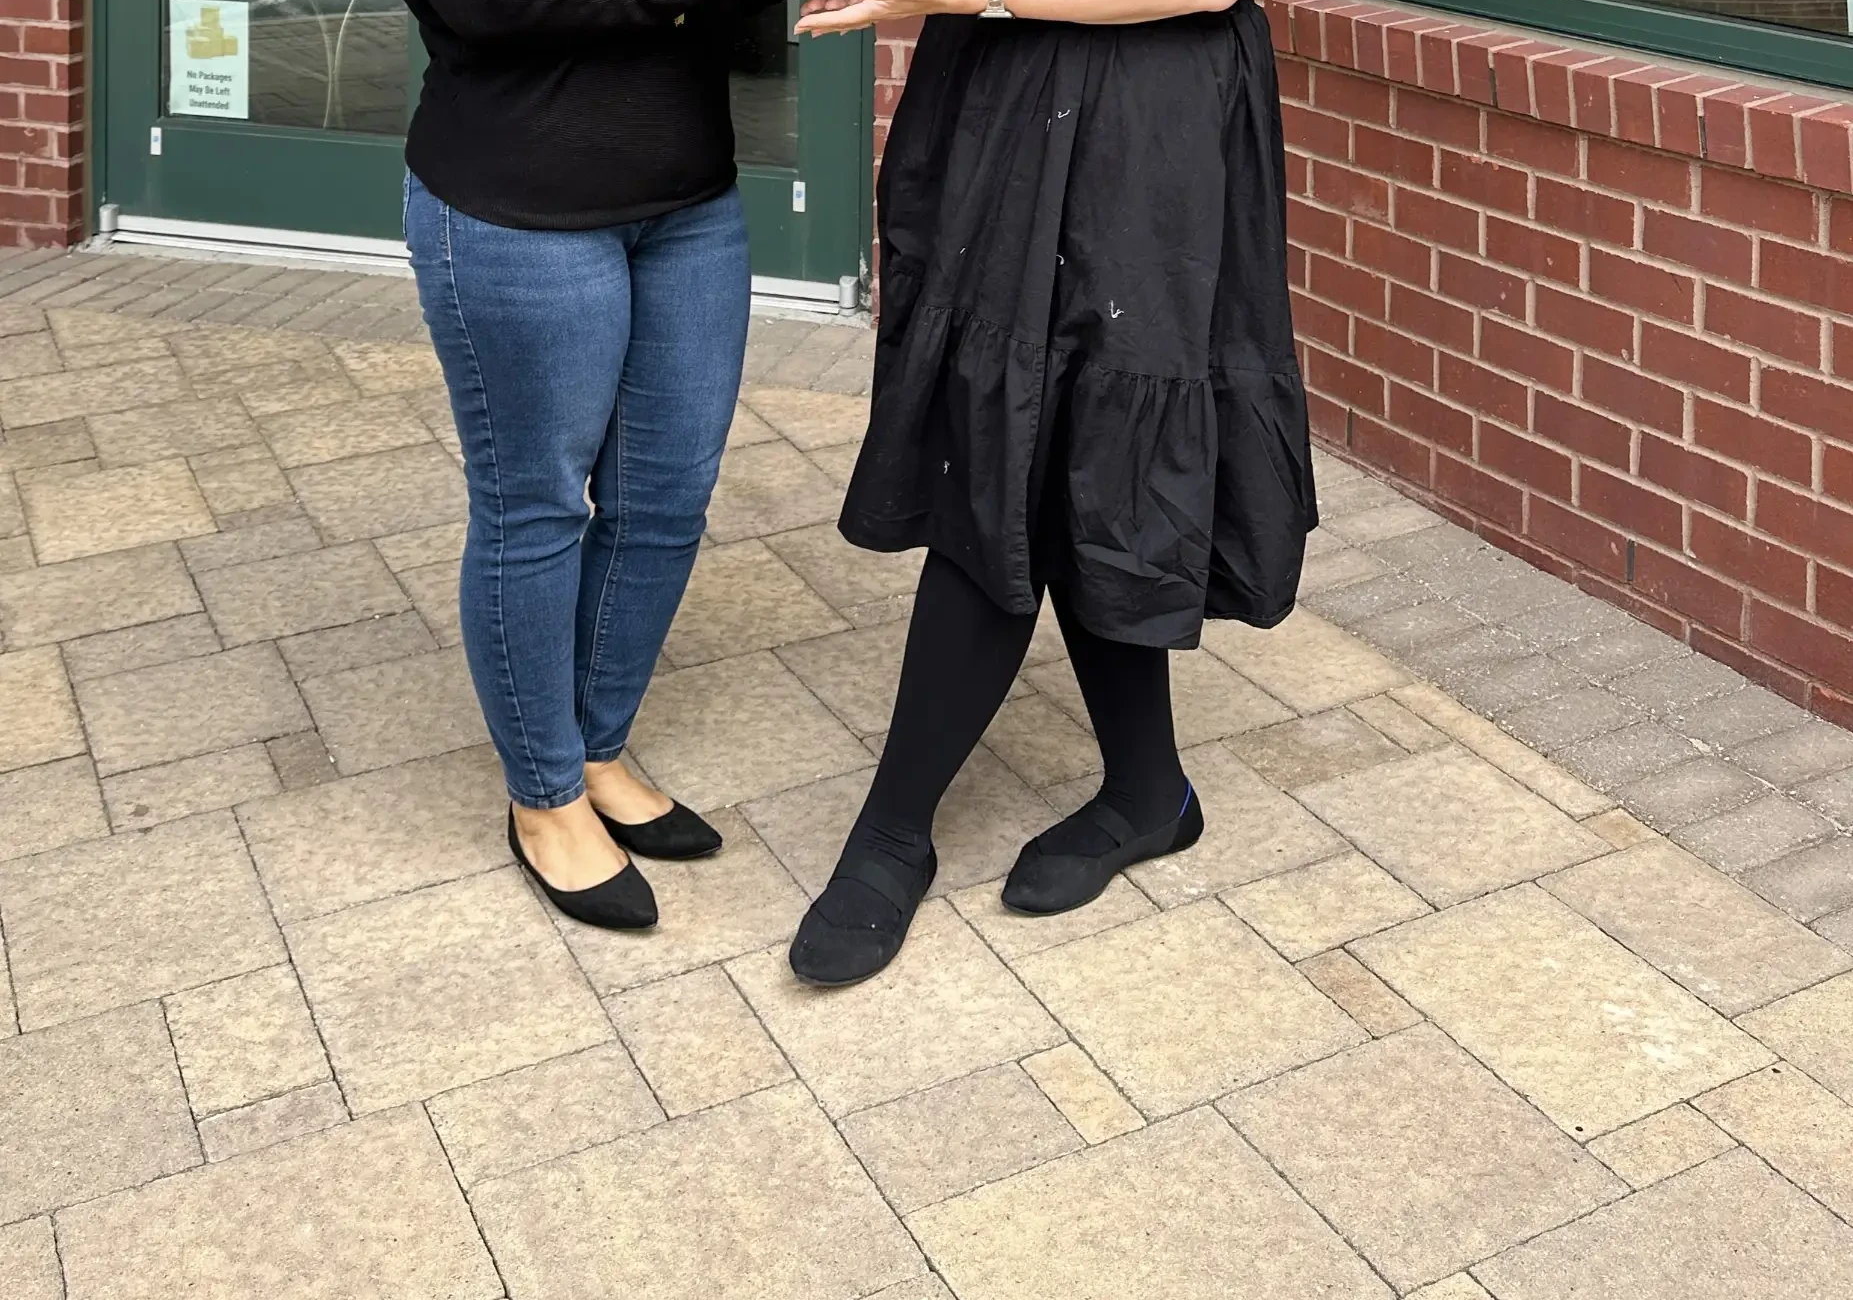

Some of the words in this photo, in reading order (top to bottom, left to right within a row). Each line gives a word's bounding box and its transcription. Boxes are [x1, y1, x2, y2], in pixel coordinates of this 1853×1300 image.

[187, 70, 197, 79] No
[198, 71, 232, 83] Packages
[189, 84, 203, 96] May
[205, 85, 214, 94] Be
[215, 87, 231, 96] Left
[189, 98, 229, 110] Unattended
